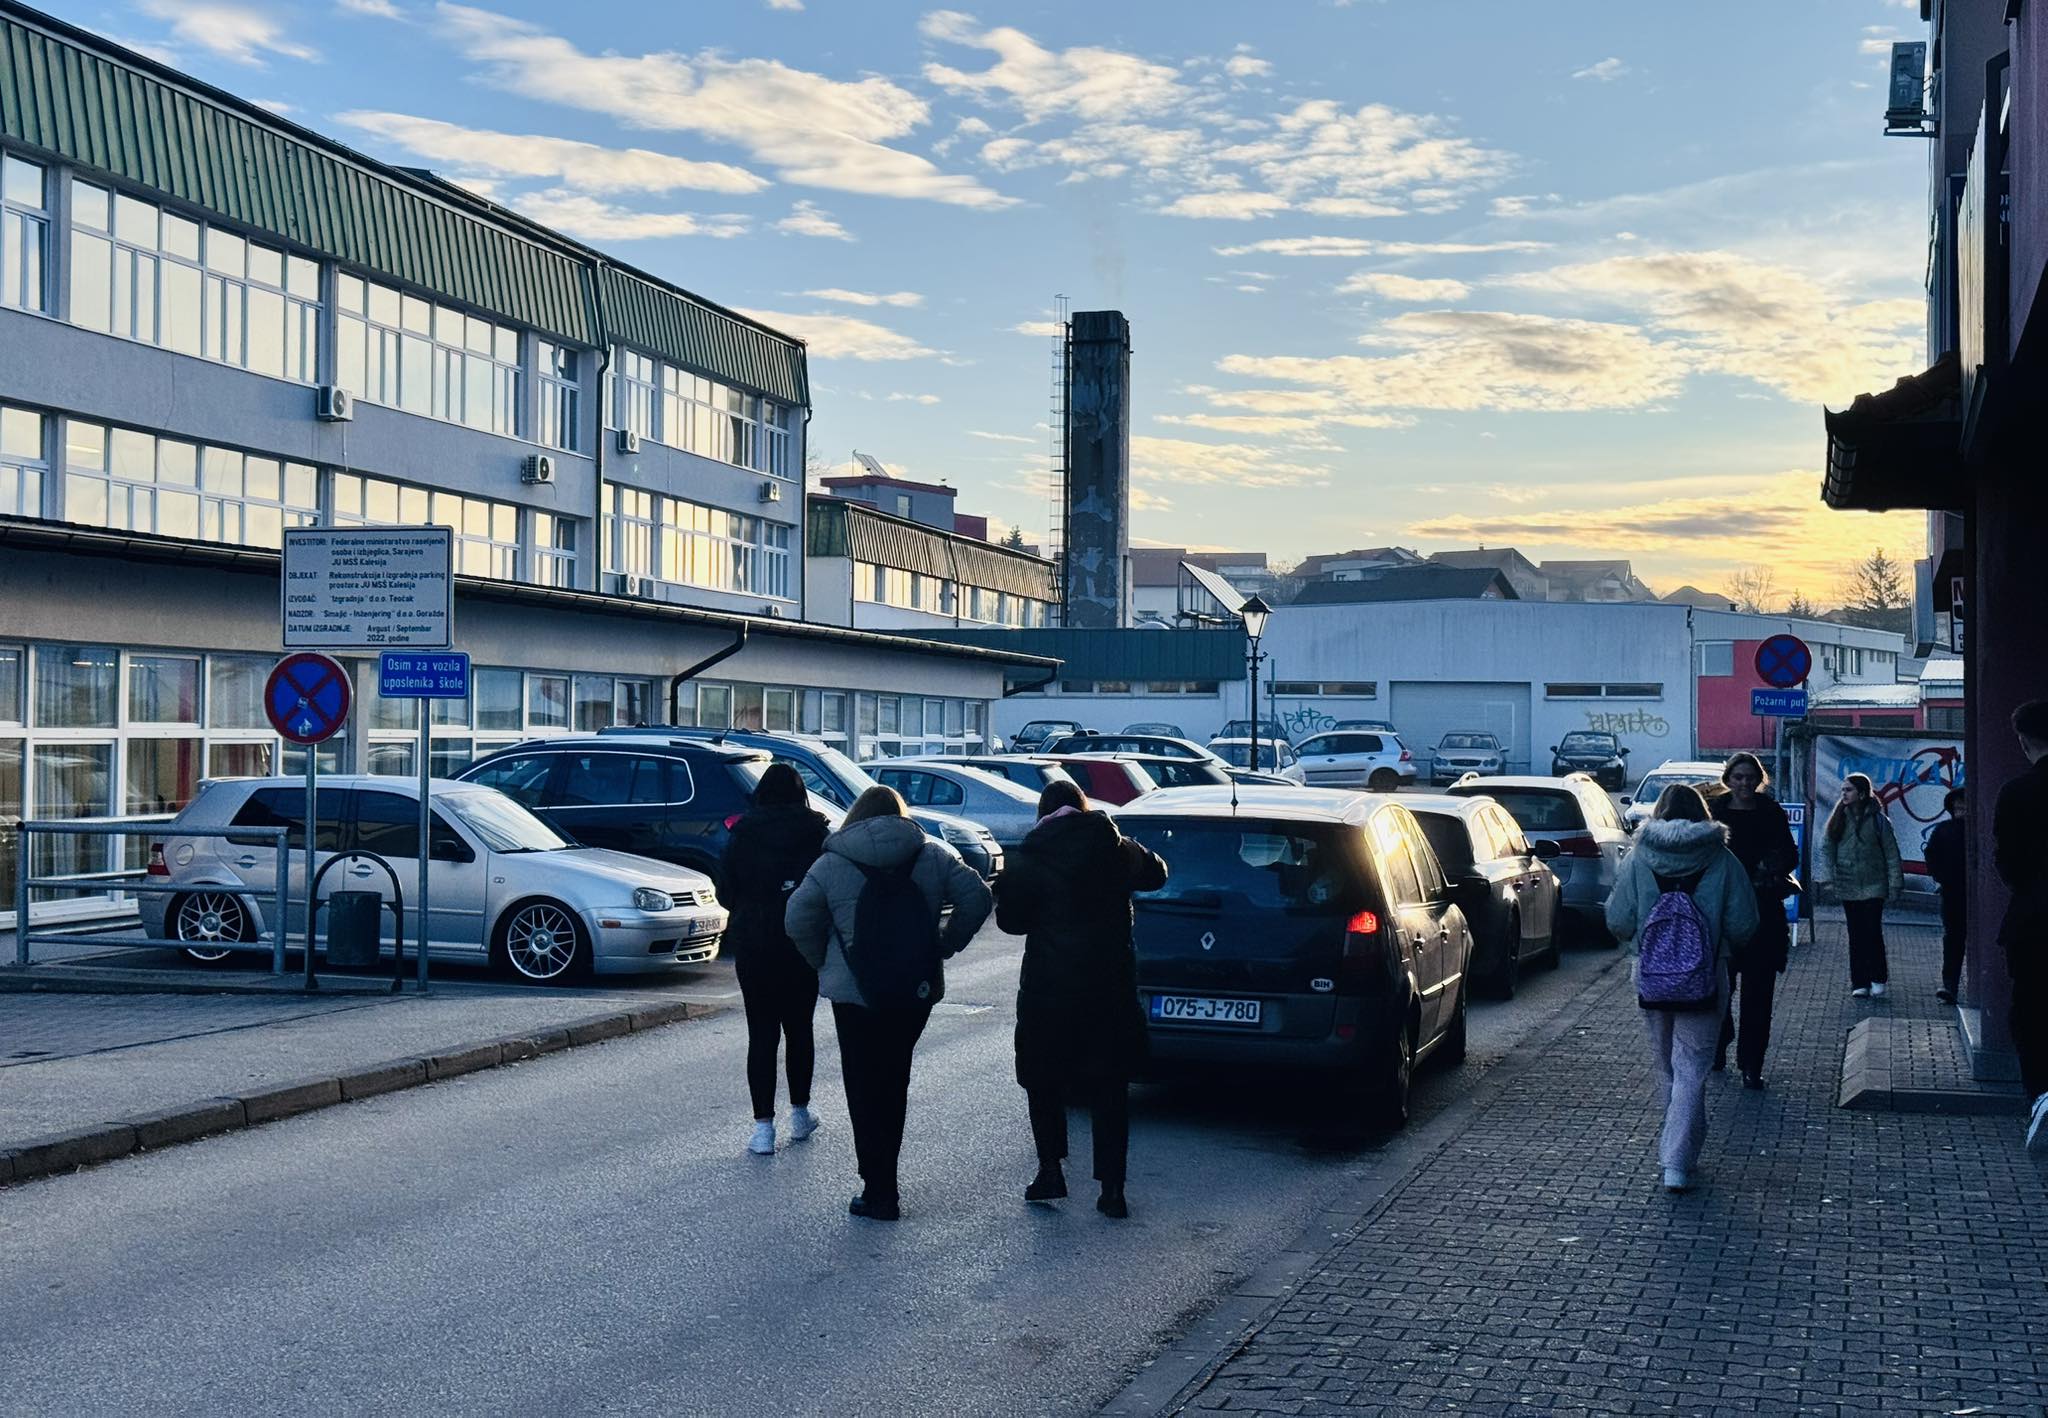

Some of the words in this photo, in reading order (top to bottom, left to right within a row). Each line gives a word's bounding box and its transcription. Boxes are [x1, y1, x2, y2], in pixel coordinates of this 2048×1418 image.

[331, 537, 365, 546] Federalno
[366, 538, 410, 546] ministarstvo
[411, 538, 446, 547] raseljenih
[331, 548, 352, 556] osoba
[392, 548, 424, 557] Sarajevo
[360, 558, 387, 567] Kalesija
[329, 571, 381, 580] Rekonstrukcija
[386, 571, 418, 580] izgradnja
[419, 571, 445, 580] parking
[329, 582, 359, 590] prostora
[361, 581, 371, 589] JU
[389, 581, 416, 590] Kalesija
[389, 594, 415, 602] Teočak
[288, 624, 312, 632] DATUM
[367, 625, 391, 633] Avgust
[396, 624, 432, 633] Septembar
[388, 635, 410, 643] godine
[387, 658, 411, 671] Osim
[416, 661, 428, 671] za
[432, 659, 460, 672] vozila
[384, 676, 434, 691] uposlenika
[439, 676, 464, 689] škole
[1754, 695, 1787, 707] Požarni
[1790, 697, 1805, 709] put
[1313, 980, 1331, 989] BIH
[1163, 997, 1258, 1020] 075-J-780
